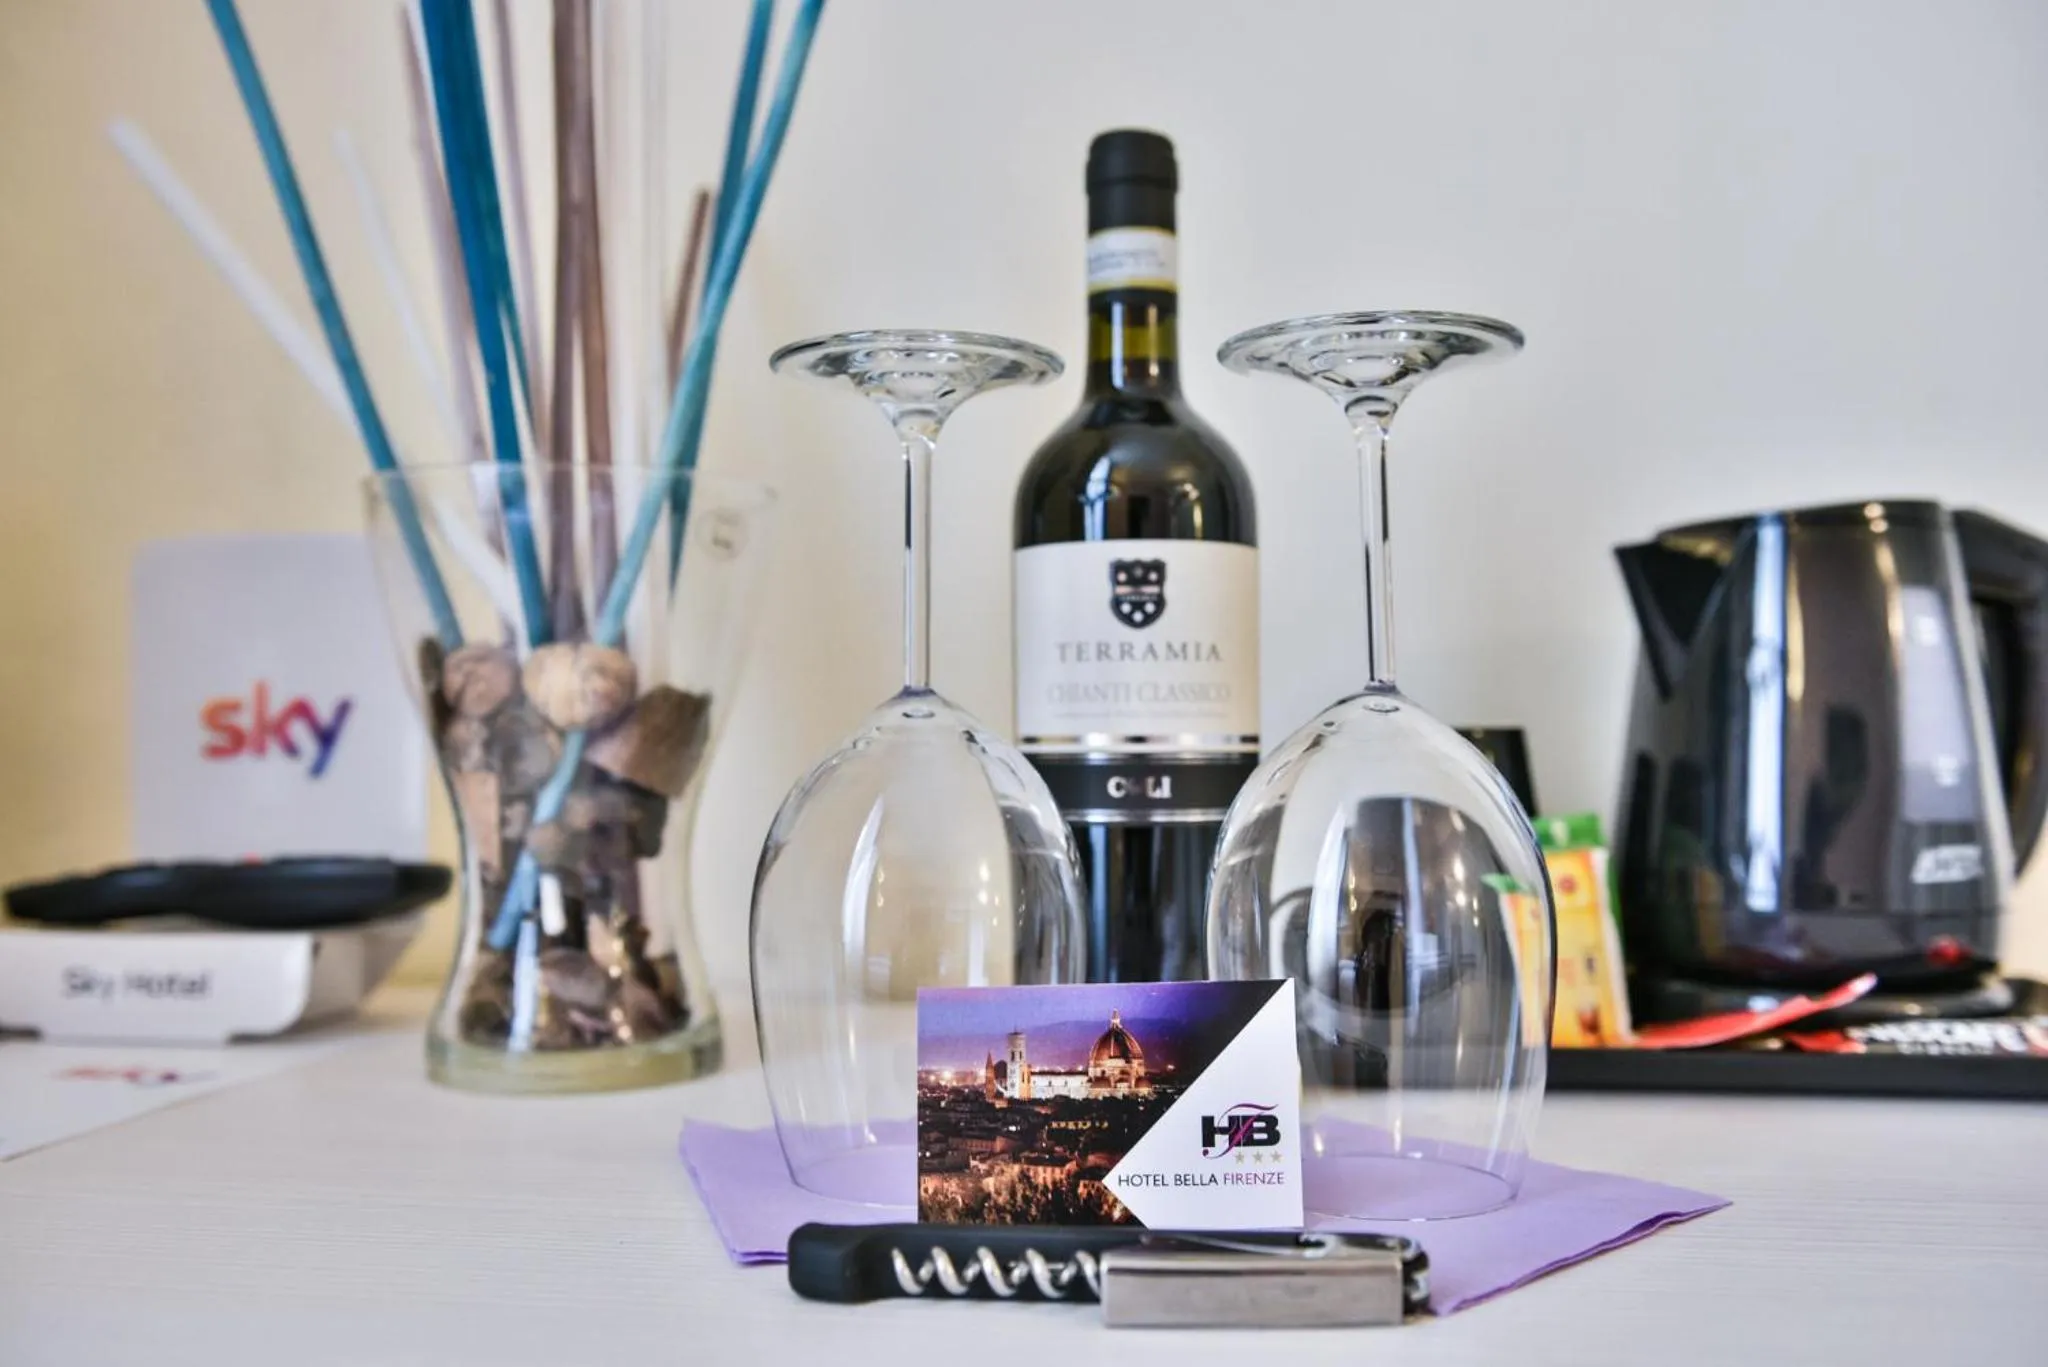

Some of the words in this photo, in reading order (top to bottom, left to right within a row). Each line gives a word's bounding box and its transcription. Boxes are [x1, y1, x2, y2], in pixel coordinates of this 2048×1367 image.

[1056, 641, 1223, 663] TERRAMIA
[1047, 682, 1131, 704] CHIANTI
[1136, 682, 1231, 702] CLASSICO
[200, 680, 353, 778] sky
[1118, 1174, 1168, 1187] HOTEL
[1174, 1173, 1218, 1186] BELLA
[1224, 1172, 1285, 1185] FIRENZE
